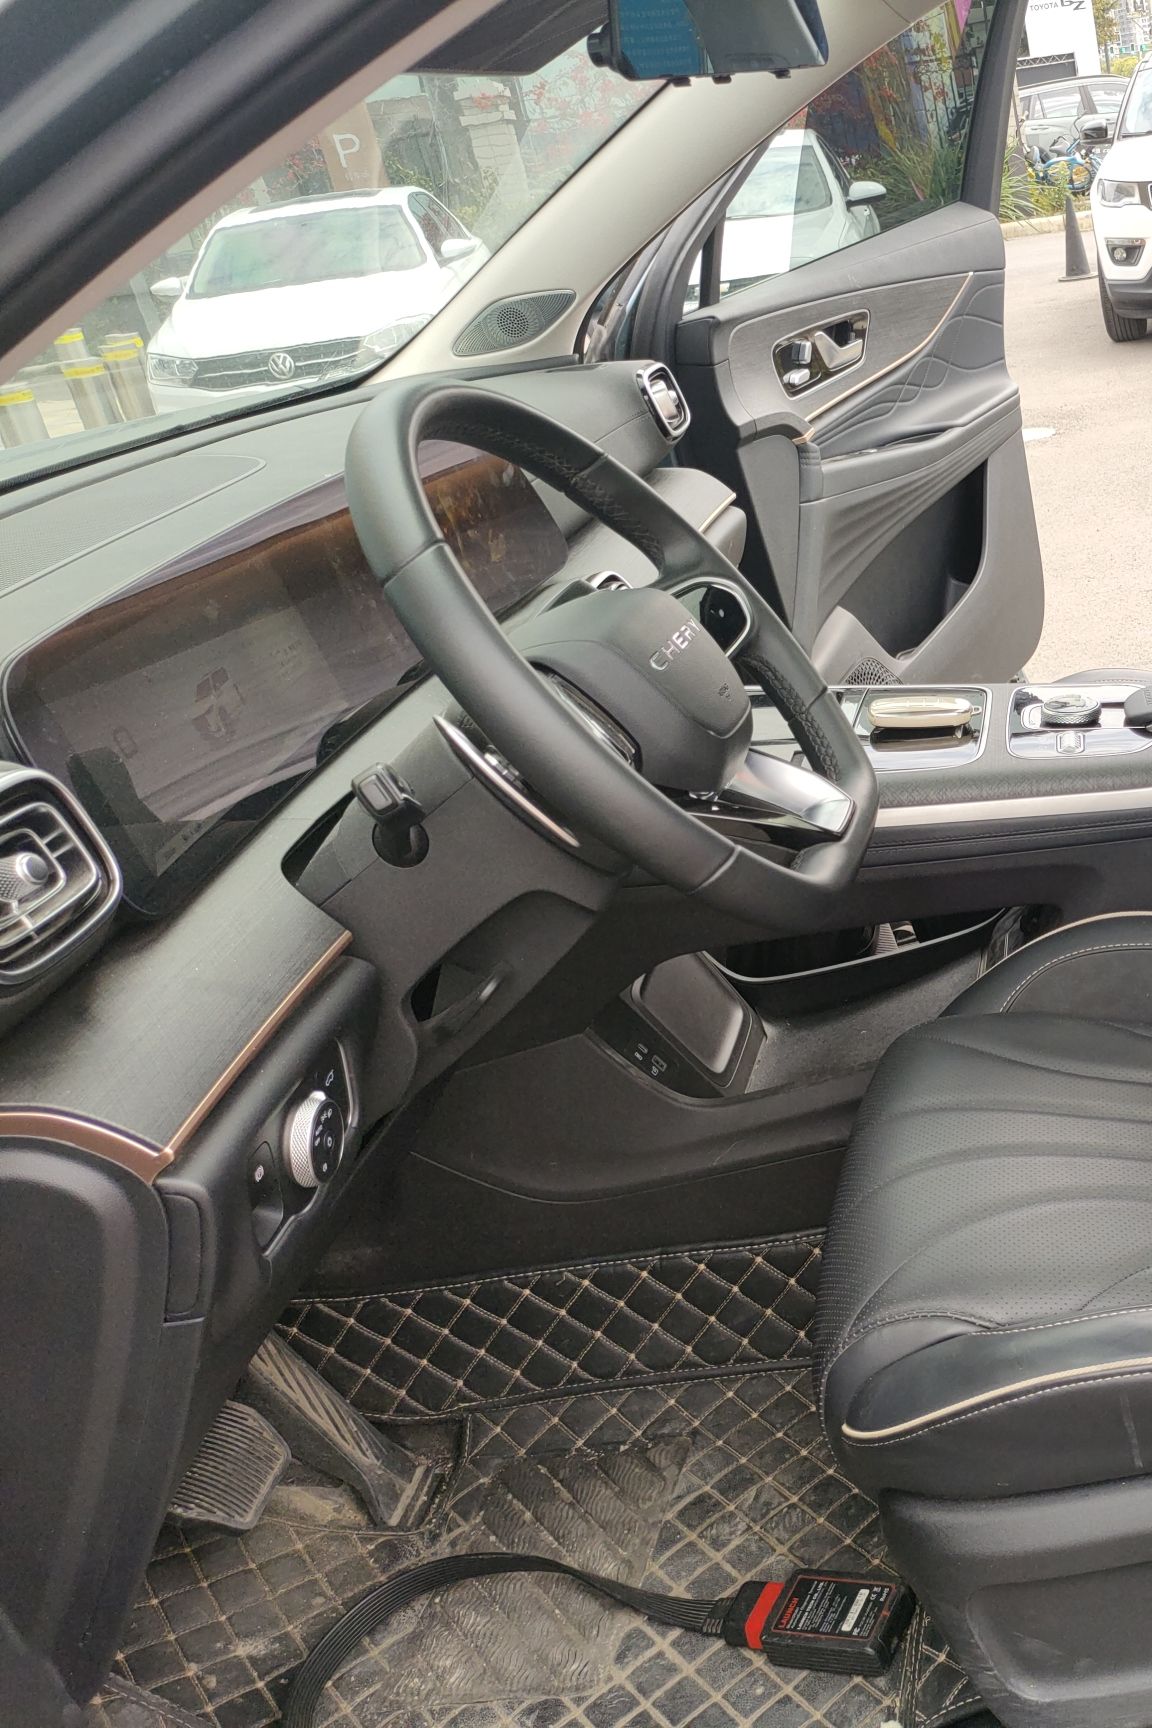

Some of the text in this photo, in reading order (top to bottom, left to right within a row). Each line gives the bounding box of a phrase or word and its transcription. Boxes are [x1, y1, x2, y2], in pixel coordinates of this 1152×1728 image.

[1030, 2, 1058, 11] TOYOTA
[333, 133, 360, 168] P
[649, 618, 700, 670] CHERY
[779, 1597, 799, 1628] LAUNCH
